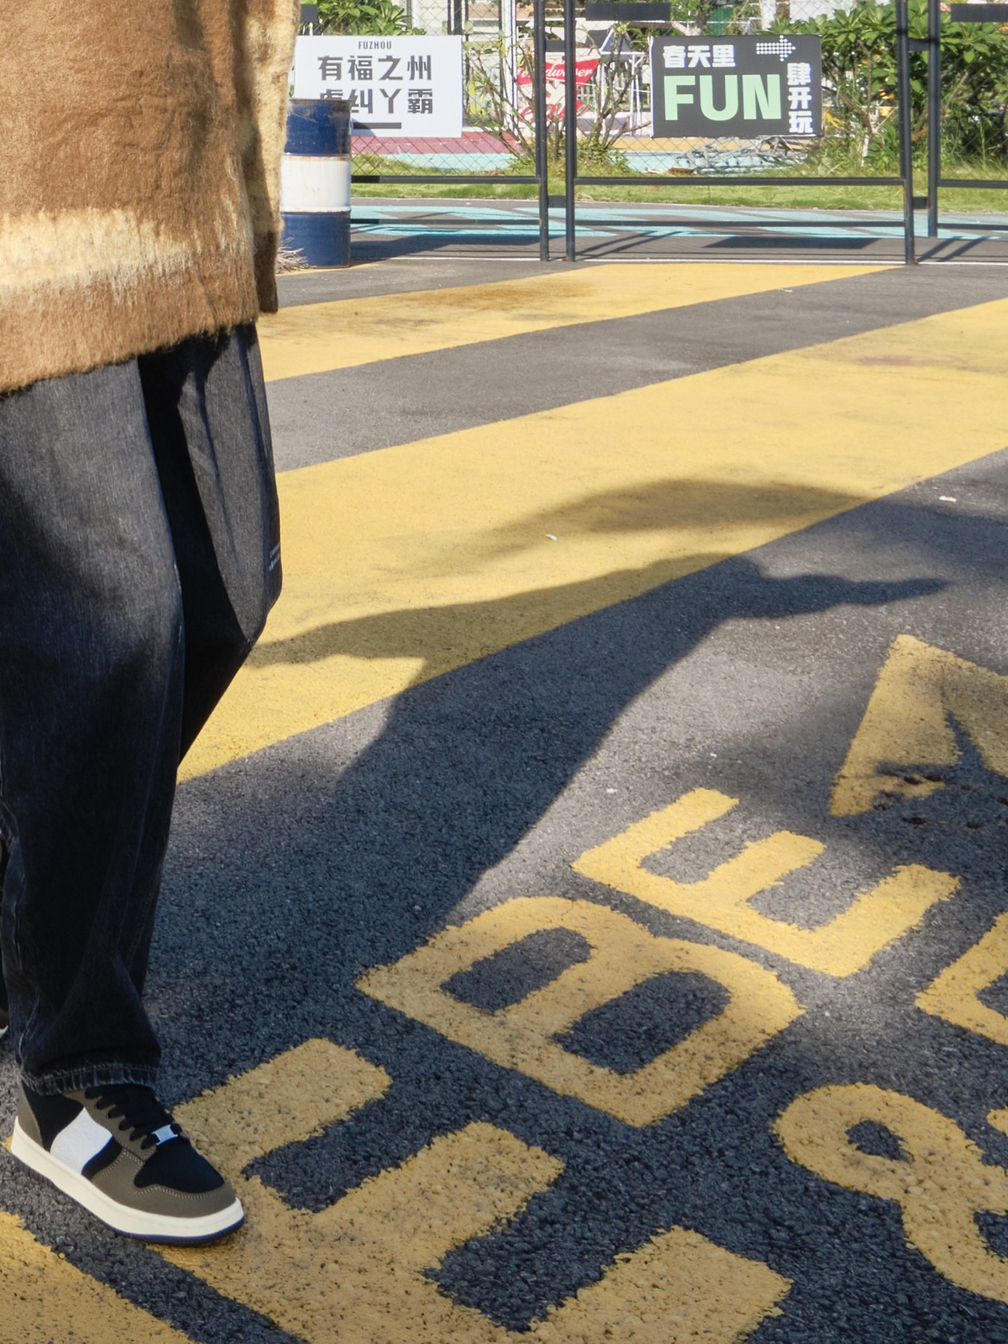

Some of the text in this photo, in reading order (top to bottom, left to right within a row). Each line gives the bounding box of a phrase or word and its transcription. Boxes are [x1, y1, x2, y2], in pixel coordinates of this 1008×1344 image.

[358, 41, 392, 50] FUZHOU
[663, 44, 737, 69] 春天里
[317, 55, 432, 81] 有福之州
[663, 73, 782, 121] FUN
[786, 62, 814, 134] 肆开玩
